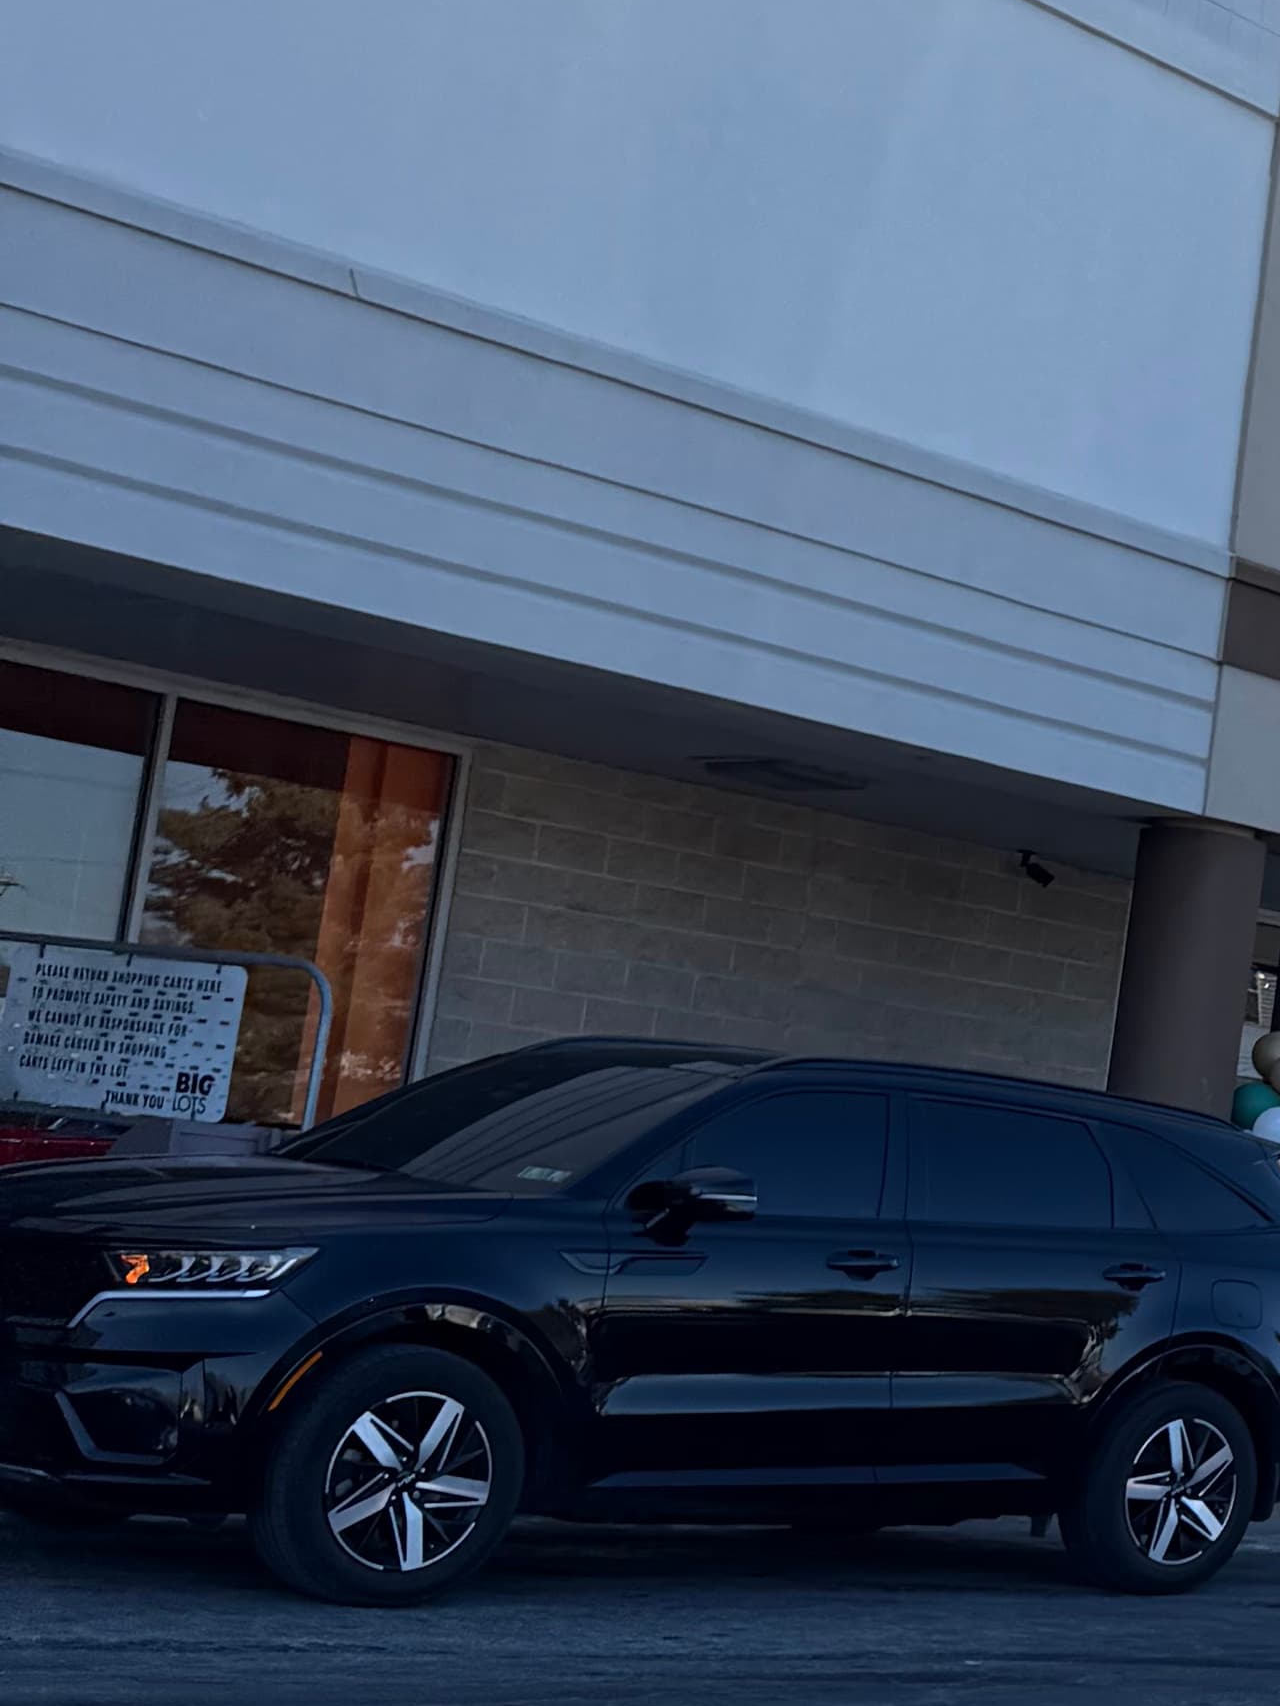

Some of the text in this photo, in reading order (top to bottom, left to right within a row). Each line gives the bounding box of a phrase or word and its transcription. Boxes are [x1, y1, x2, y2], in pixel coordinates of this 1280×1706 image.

[36, 963, 70, 979] PLEASE
[112, 970, 161, 987] SHOPPING
[163, 975, 194, 991] CARTS
[196, 979, 222, 994] HERE
[32, 985, 44, 999] TO
[46, 987, 91, 1004] PROMOTE
[93, 992, 128, 1008] SAFETY
[130, 996, 150, 1010] AND
[28, 1009, 41, 1023] WE
[45, 1010, 81, 1026] CANNOT
[84, 1015, 96, 1029] BE
[23, 1030, 167, 1059] DAMAGE CAUSED BY SHOPPING
[20, 1054, 48, 1070] CARTS
[51, 1056, 74, 1072] LEFT
[89, 1061, 107, 1076] THE
[175, 1071, 216, 1096] BIG
[105, 1089, 165, 1110] THANK YOU
[172, 1094, 206, 1115] LOTS
